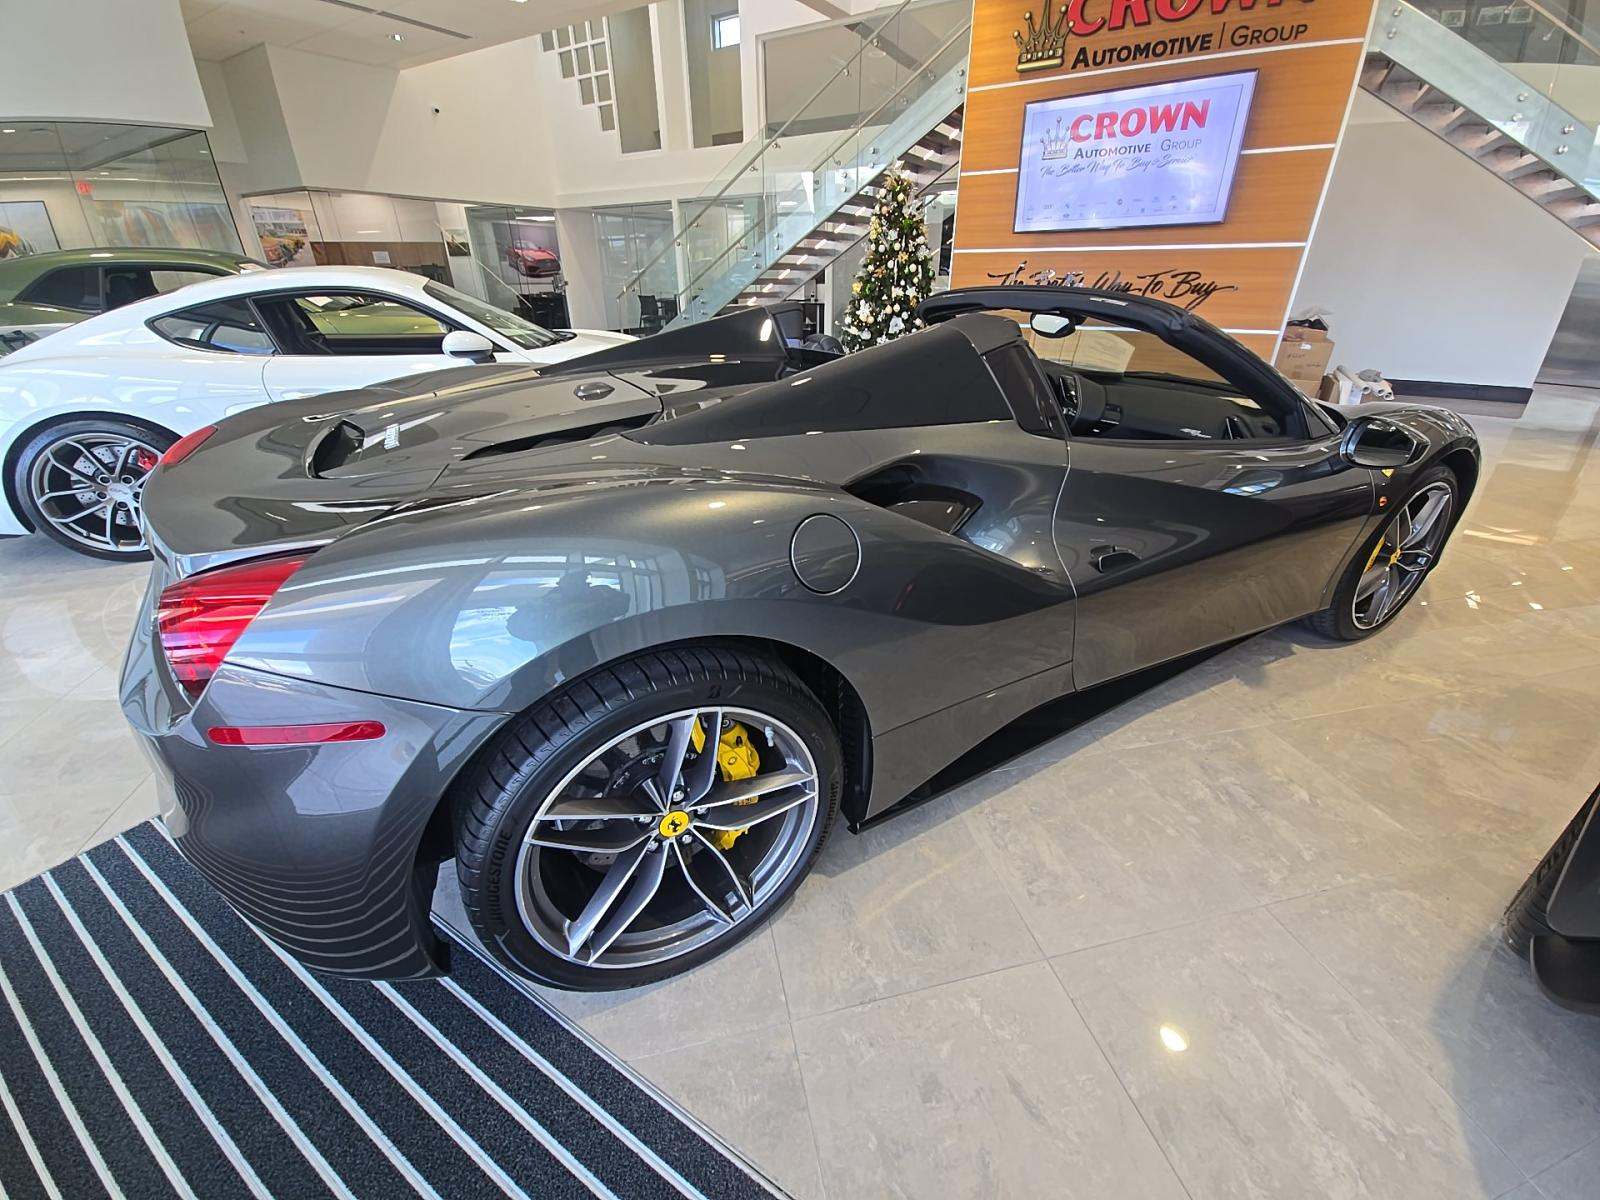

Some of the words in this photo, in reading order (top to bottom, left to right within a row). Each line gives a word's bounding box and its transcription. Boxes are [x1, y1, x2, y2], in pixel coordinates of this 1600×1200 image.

[1071, 32, 1213, 70] AUTOMOTIVE
[1230, 23, 1308, 47] GROUP
[1069, 99, 1212, 143] CROWN
[1073, 143, 1151, 160] AUTOMOTIVE
[1160, 138, 1202, 152] GROUP
[1137, 268, 1178, 298] To
[1164, 271, 1235, 311] Buy
[486, 829, 513, 925] BRIDGESTONE
